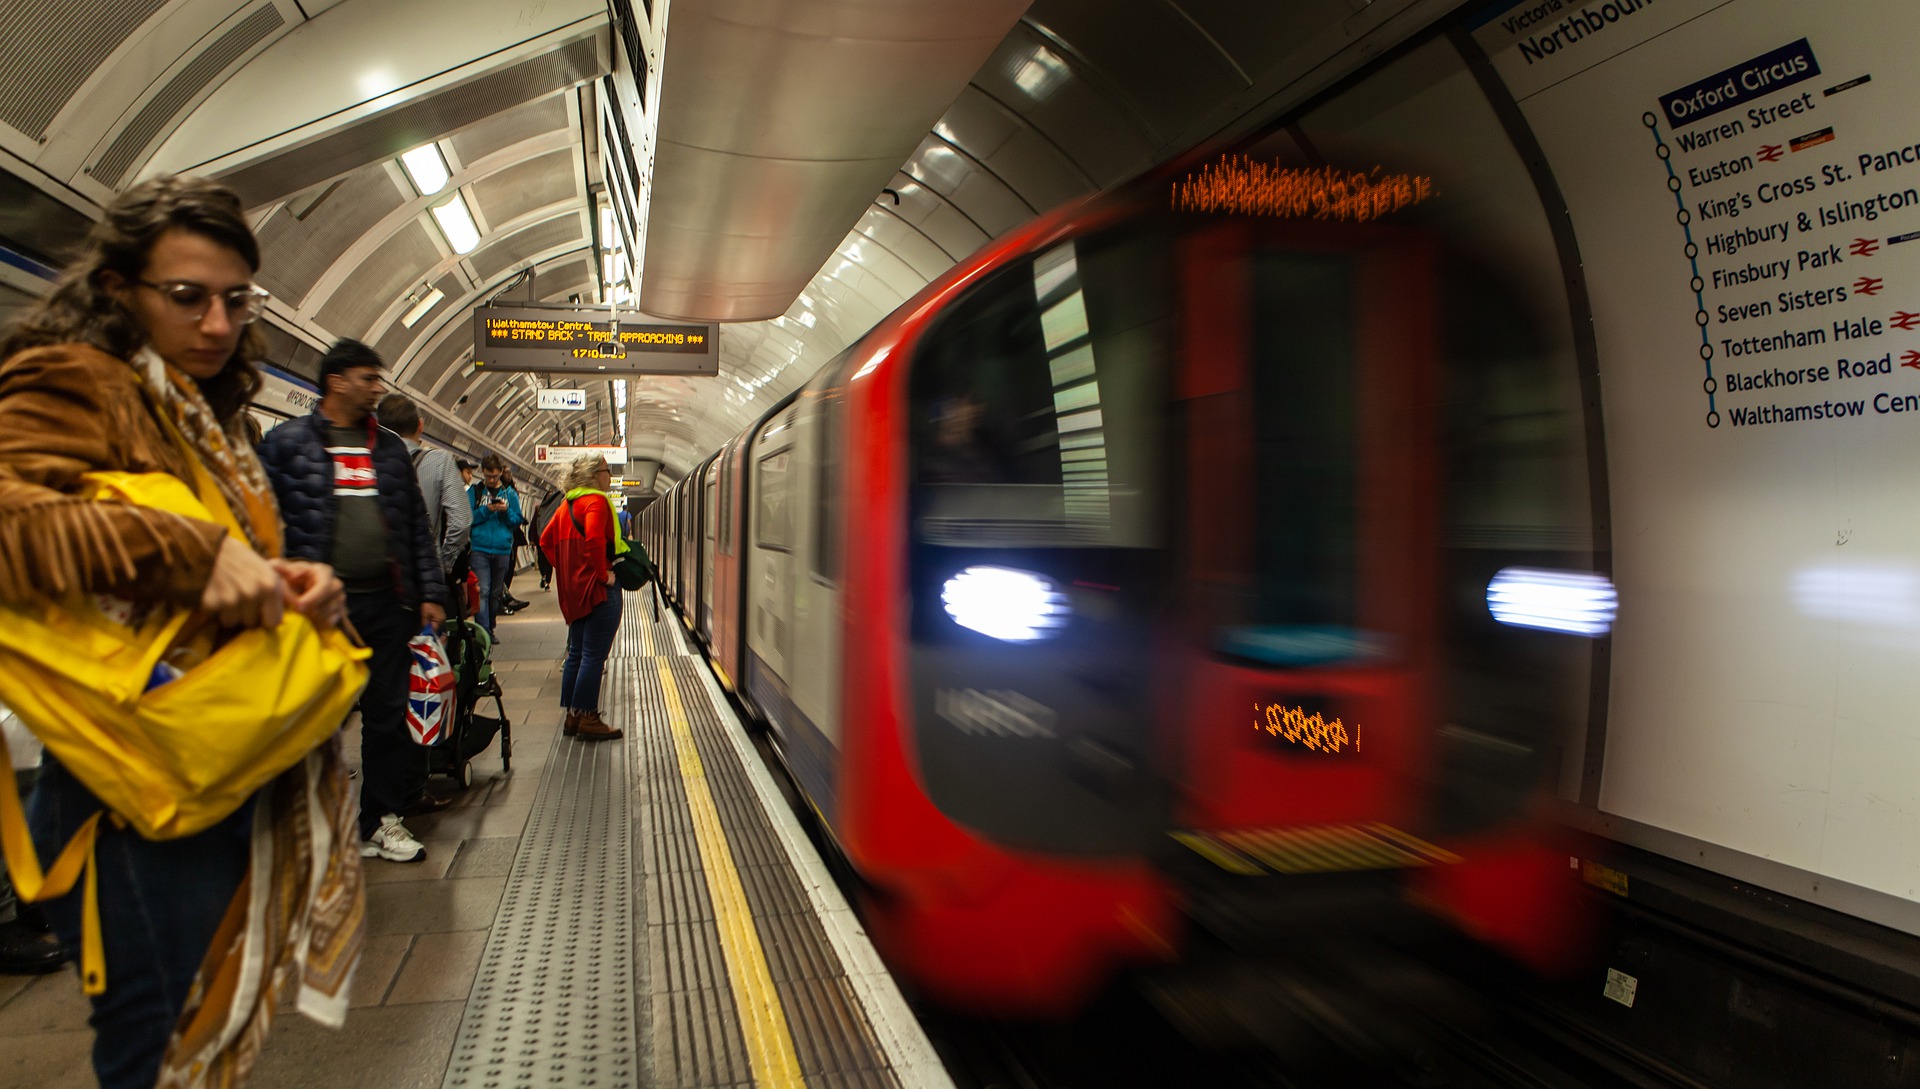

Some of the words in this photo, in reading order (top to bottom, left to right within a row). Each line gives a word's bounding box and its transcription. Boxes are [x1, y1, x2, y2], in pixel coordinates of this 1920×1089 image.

[1501, 0, 1563, 34] Victoria
[1670, 78, 1738, 118] Oxford
[1740, 55, 1809, 91] Circus
[1676, 119, 1745, 153] Warren
[1748, 92, 1815, 129] Street
[1688, 155, 1753, 187] Euston
[1757, 175, 1816, 203] Cross
[1821, 163, 1852, 186] St.
[1706, 220, 1789, 255] Highbury
[1797, 211, 1813, 233] &
[1818, 188, 1919, 227] Islington
[1712, 259, 1790, 289] Finsbury
[1797, 244, 1843, 271] Park
[1718, 300, 1772, 323] Seven
[1778, 286, 1847, 312] Sisters
[492, 319, 555, 330] Walthamstow
[557, 321, 593, 331] Central
[511, 329, 545, 340] STAND
[547, 330, 574, 341] BACK
[619, 332, 684, 344] APPROACHING
[1721, 328, 1826, 358] Tottenham
[1833, 317, 1883, 342] Hale
[1726, 365, 1829, 393] Blackhorse
[1837, 352, 1892, 380] Road
[1728, 400, 1865, 427] Walthamstow
[1872, 392, 1920, 415] Cen
